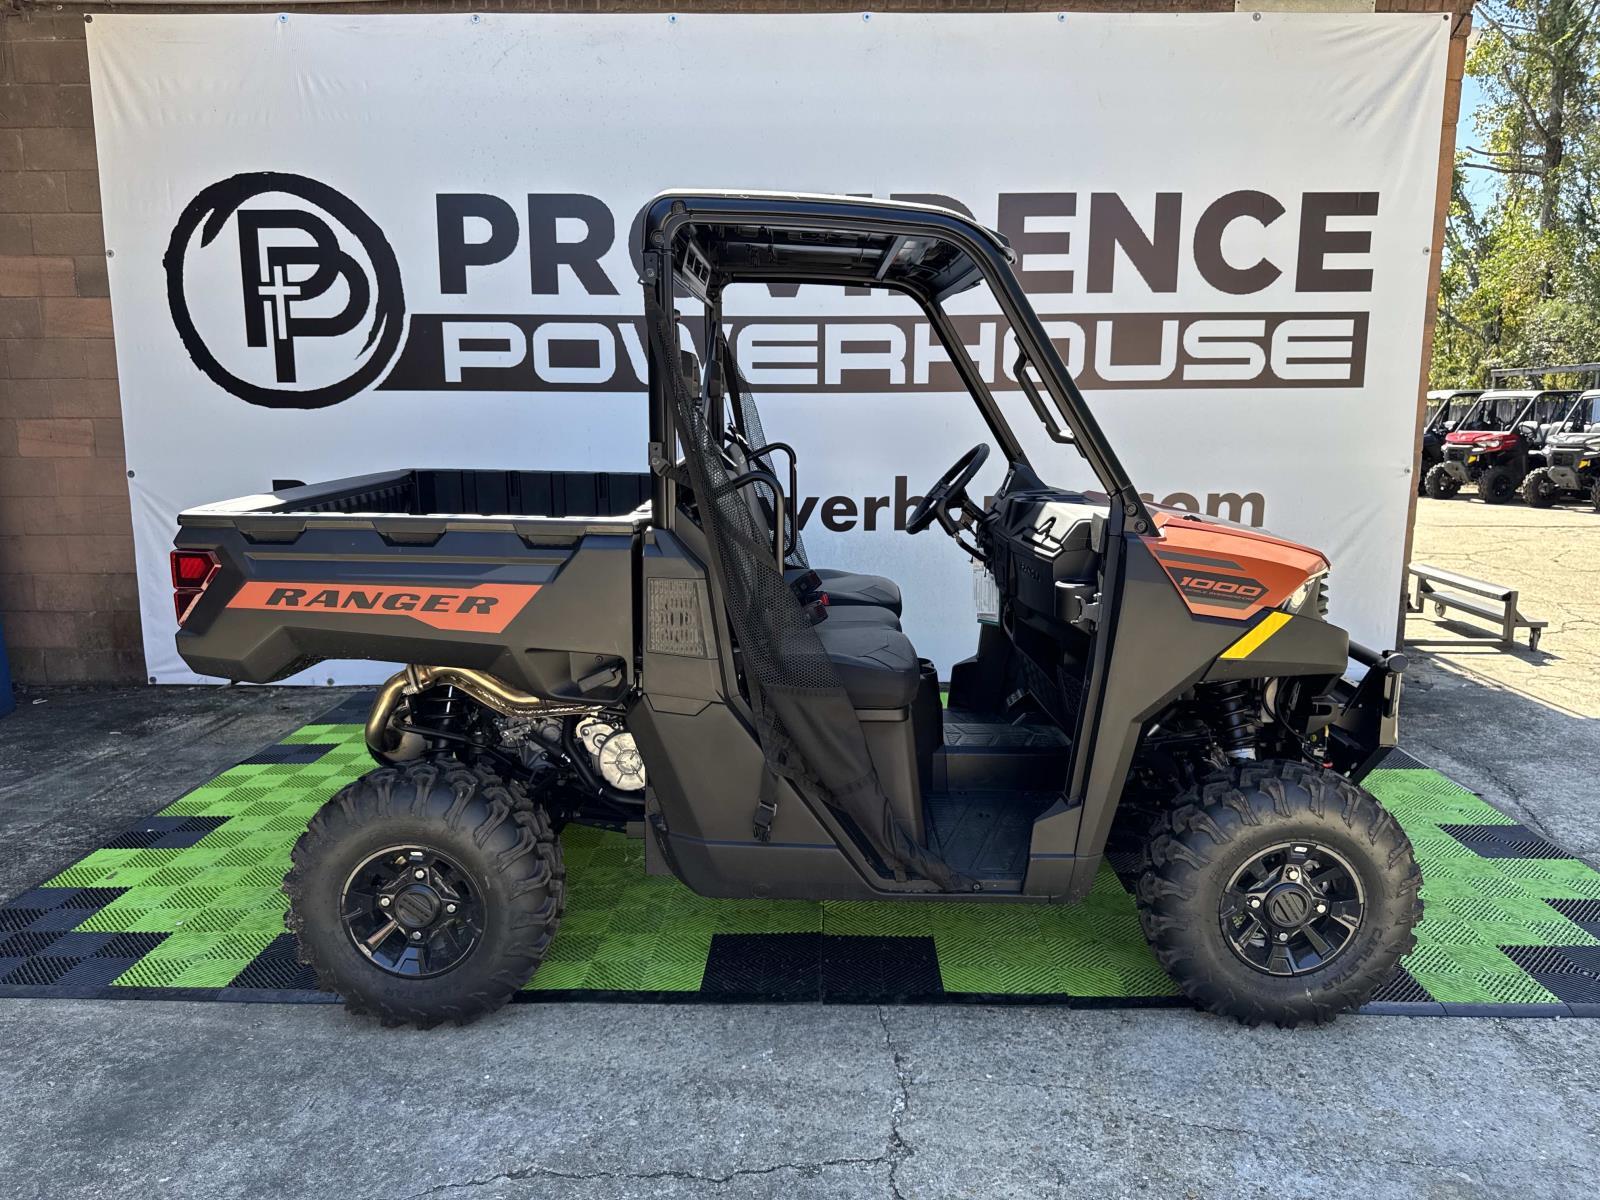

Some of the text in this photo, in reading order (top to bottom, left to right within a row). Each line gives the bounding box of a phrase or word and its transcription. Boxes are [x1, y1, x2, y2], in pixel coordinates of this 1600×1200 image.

[436, 189, 1379, 296] PRENCE
[1180, 576, 1262, 596] 1000
[265, 588, 499, 614] RANGER
